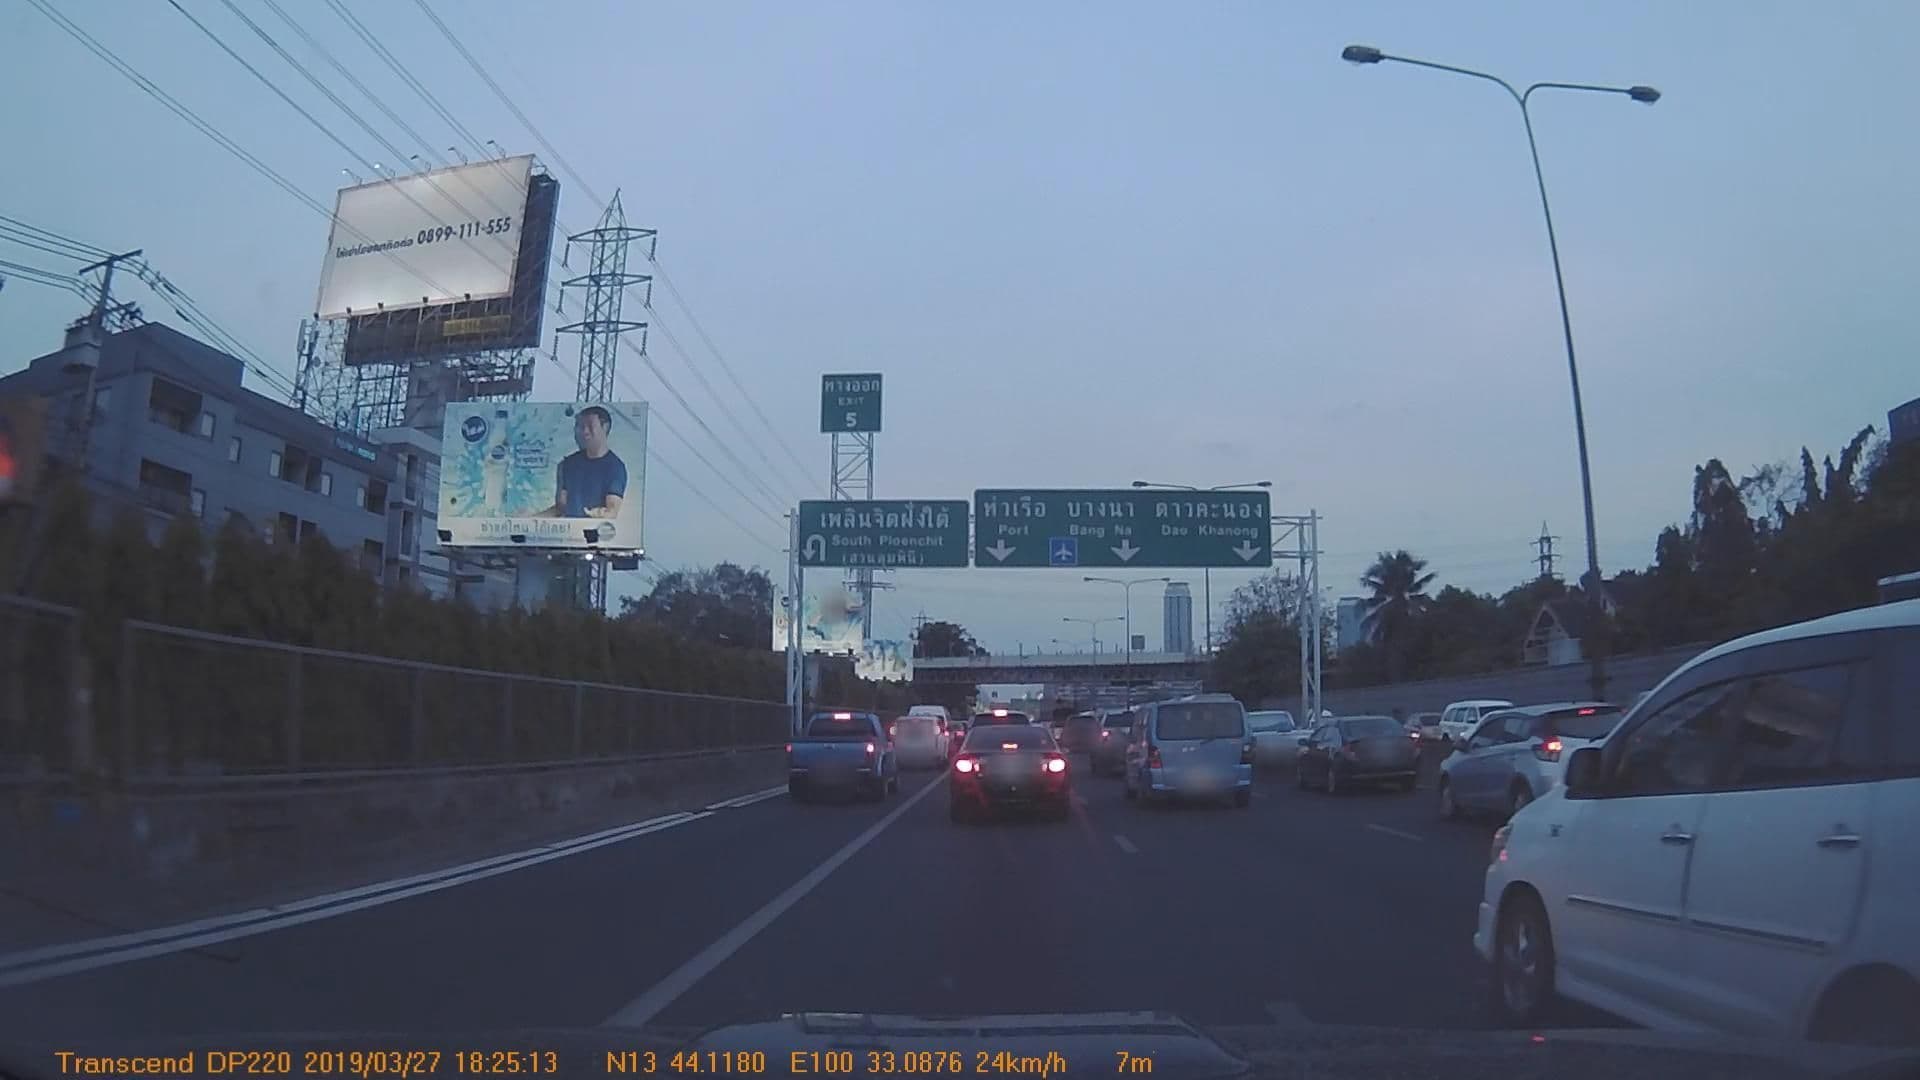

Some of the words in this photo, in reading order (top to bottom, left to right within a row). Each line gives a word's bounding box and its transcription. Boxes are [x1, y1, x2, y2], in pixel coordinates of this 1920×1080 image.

[417, 217, 511, 245] 0899-111-555
[825, 379, 880, 393] ทางออก
[838, 396, 865, 407] EXIT
[846, 412, 858, 428] 5
[983, 495, 1047, 519] ท่าเรือ
[1068, 502, 1135, 519] บางนา
[1156, 501, 1263, 519] ดาวคะนอง
[821, 502, 950, 529] เพลินจิตฝั่งใต้
[998, 524, 1029, 536] Port
[1070, 524, 1105, 538] Bang
[1115, 524, 1133, 536] Na
[1161, 524, 1188, 536] Dao
[1199, 524, 1259, 538] Khanong
[831, 534, 872, 547] South
[879, 534, 945, 547] Ploenchit
